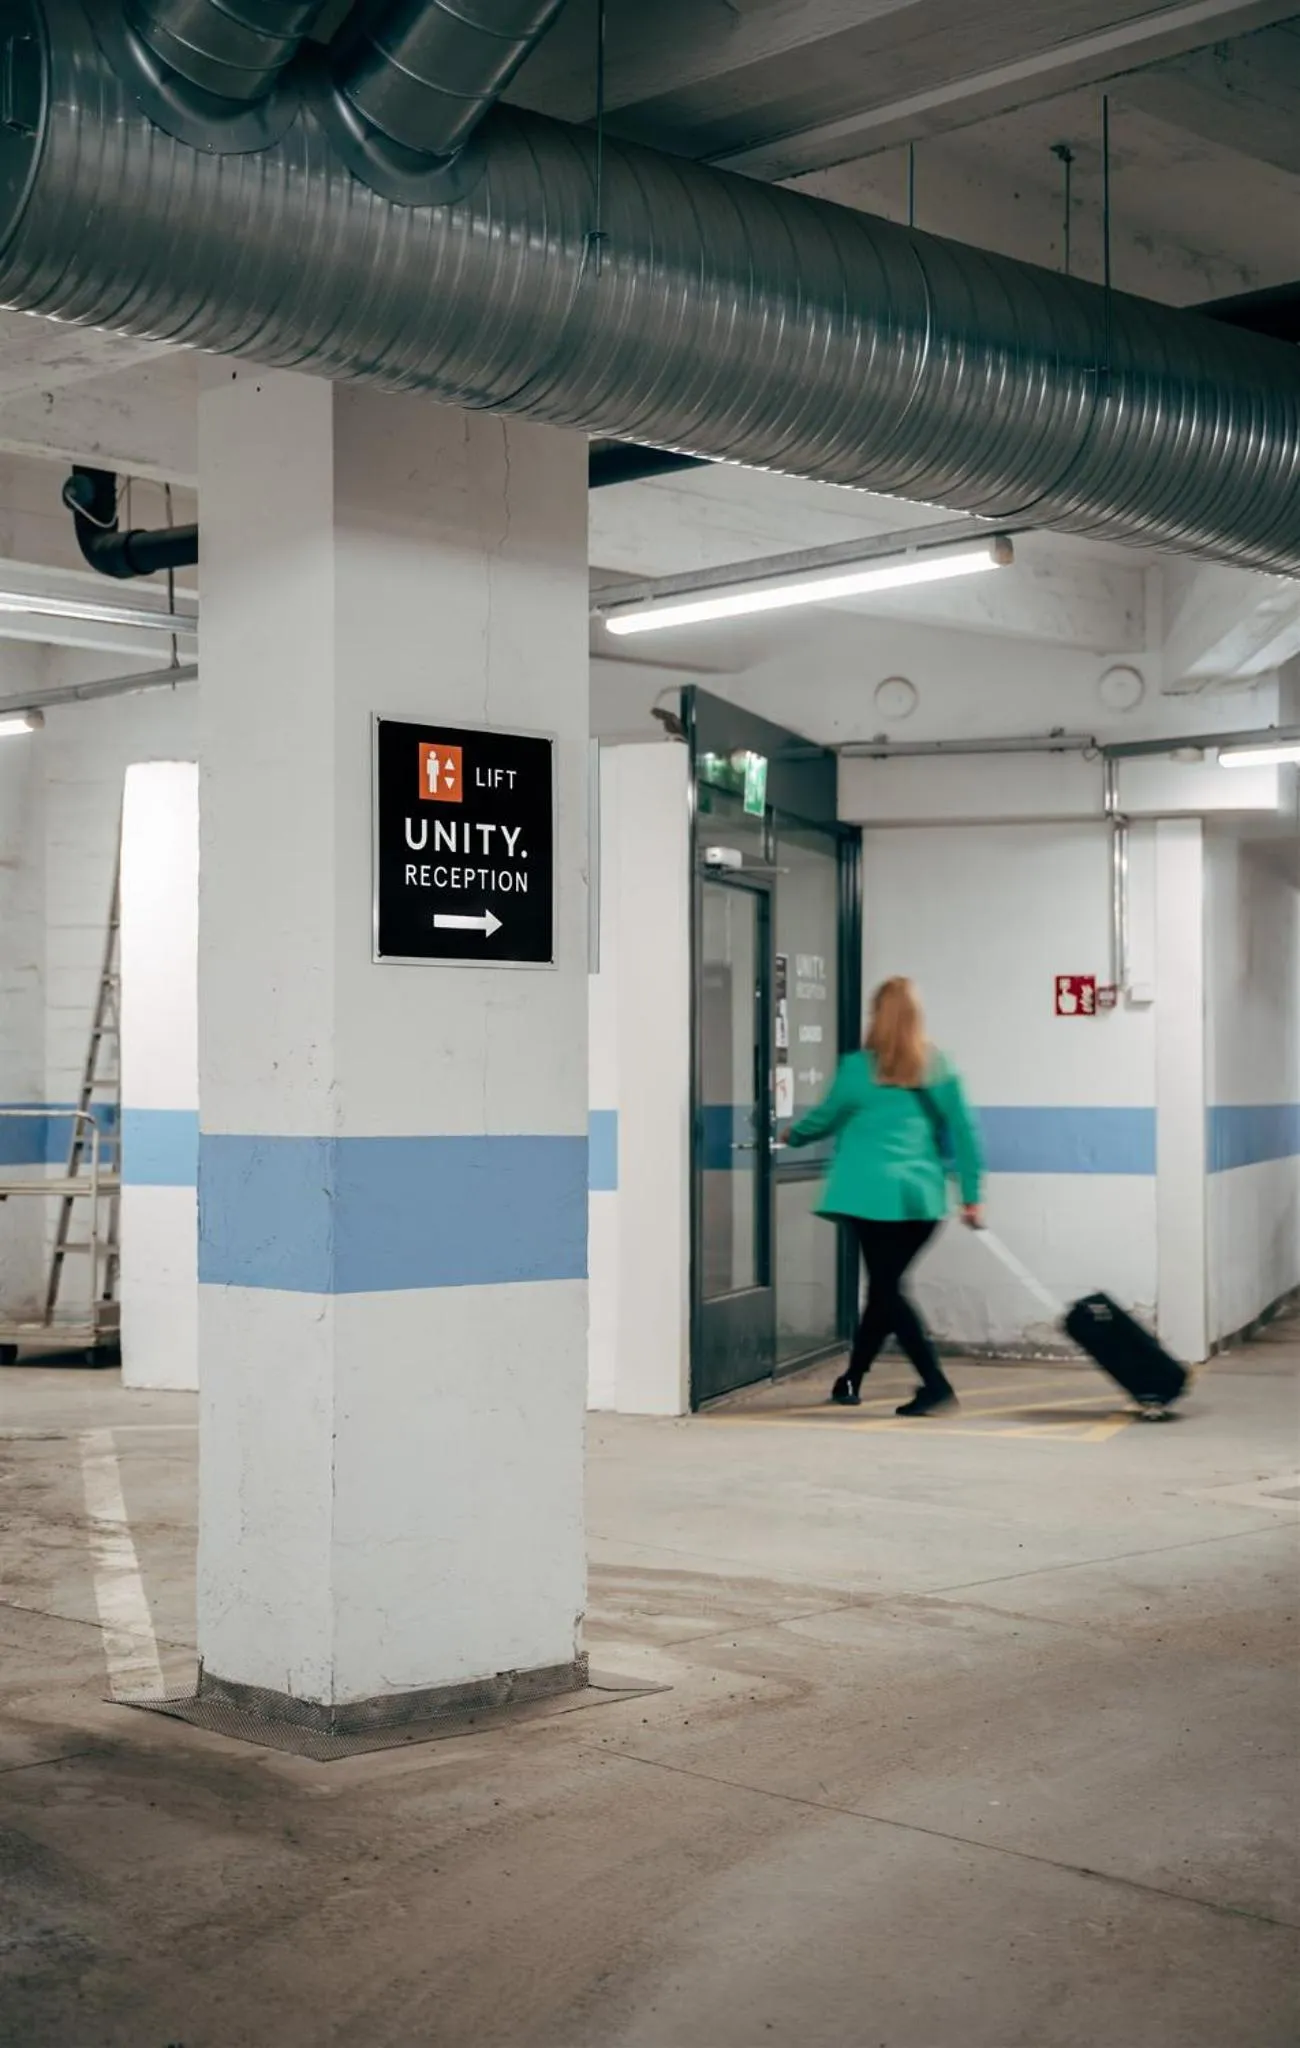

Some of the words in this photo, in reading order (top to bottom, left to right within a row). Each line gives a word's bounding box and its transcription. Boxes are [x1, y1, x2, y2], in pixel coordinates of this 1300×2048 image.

[476, 767, 517, 789] LIFT
[405, 817, 528, 858] UNITY.
[405, 864, 528, 893] RECEPTION
